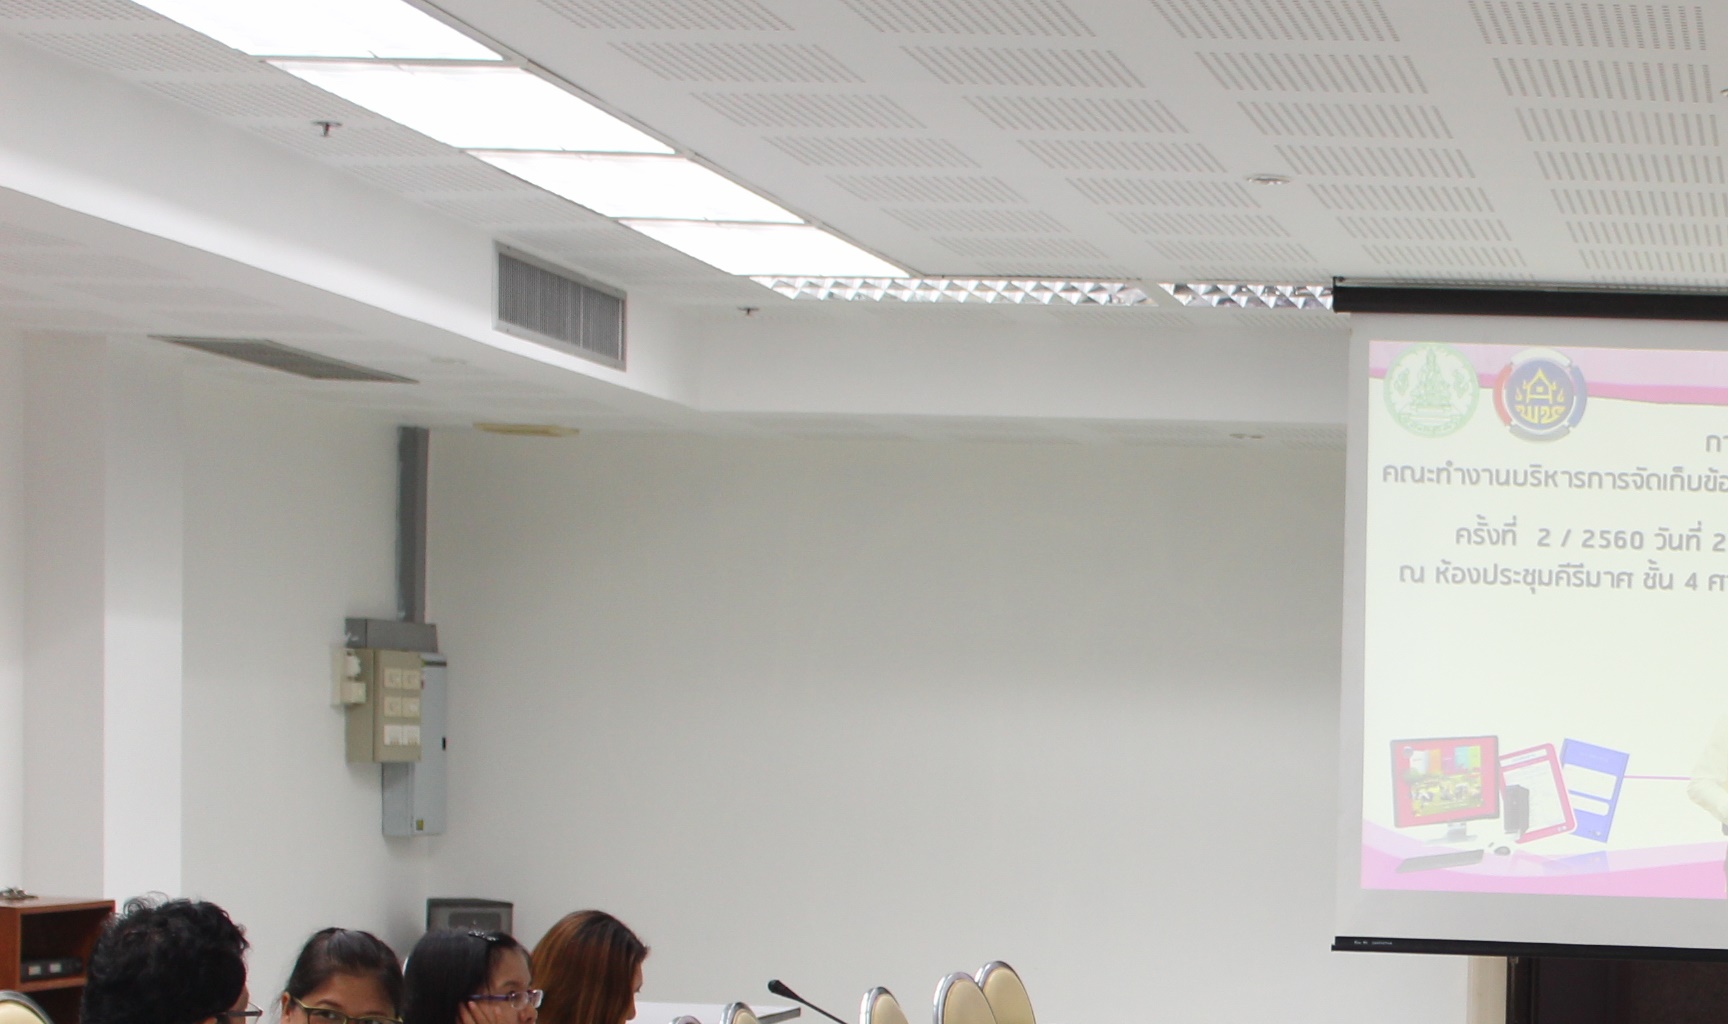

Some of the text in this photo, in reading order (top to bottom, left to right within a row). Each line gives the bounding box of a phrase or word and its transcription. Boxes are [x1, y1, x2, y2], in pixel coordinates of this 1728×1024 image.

[1456, 514, 1518, 546] ครั้งที่
[1537, 528, 1551, 547] 2
[1561, 528, 1572, 547] /
[1581, 529, 1644, 550] 2560
[1654, 521, 1702, 551] วันที่
[1400, 565, 1425, 584] ณ
[1436, 558, 1634, 594] ห้องประชุมคีรีมาศ
[1643, 559, 1673, 590] ชั้น
[1684, 572, 1699, 591] 4
